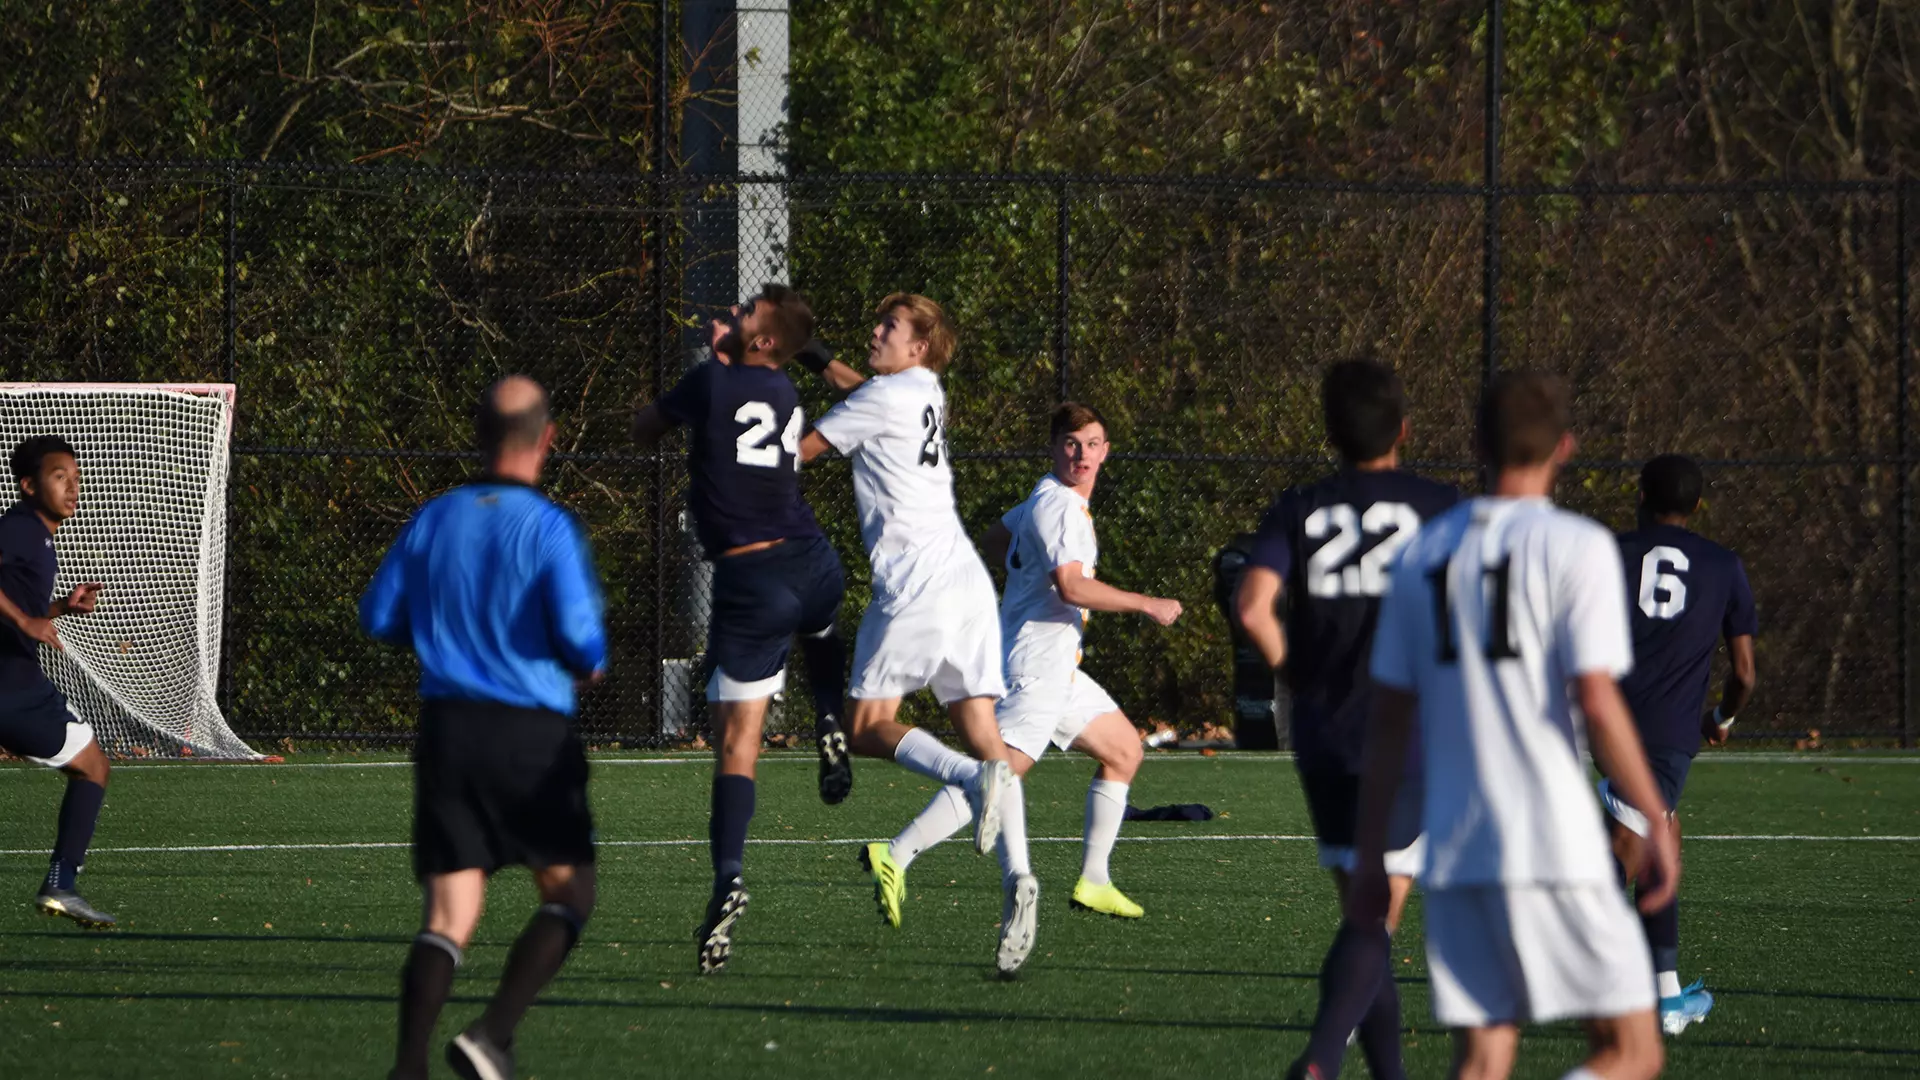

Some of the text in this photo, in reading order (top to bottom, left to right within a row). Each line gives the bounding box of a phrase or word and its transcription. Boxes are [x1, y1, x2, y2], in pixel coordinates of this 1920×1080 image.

[917, 404, 946, 468] 2
[1304, 501, 1421, 598] 22
[1638, 545, 1690, 620] 6
[1425, 553, 1522, 663] 11
